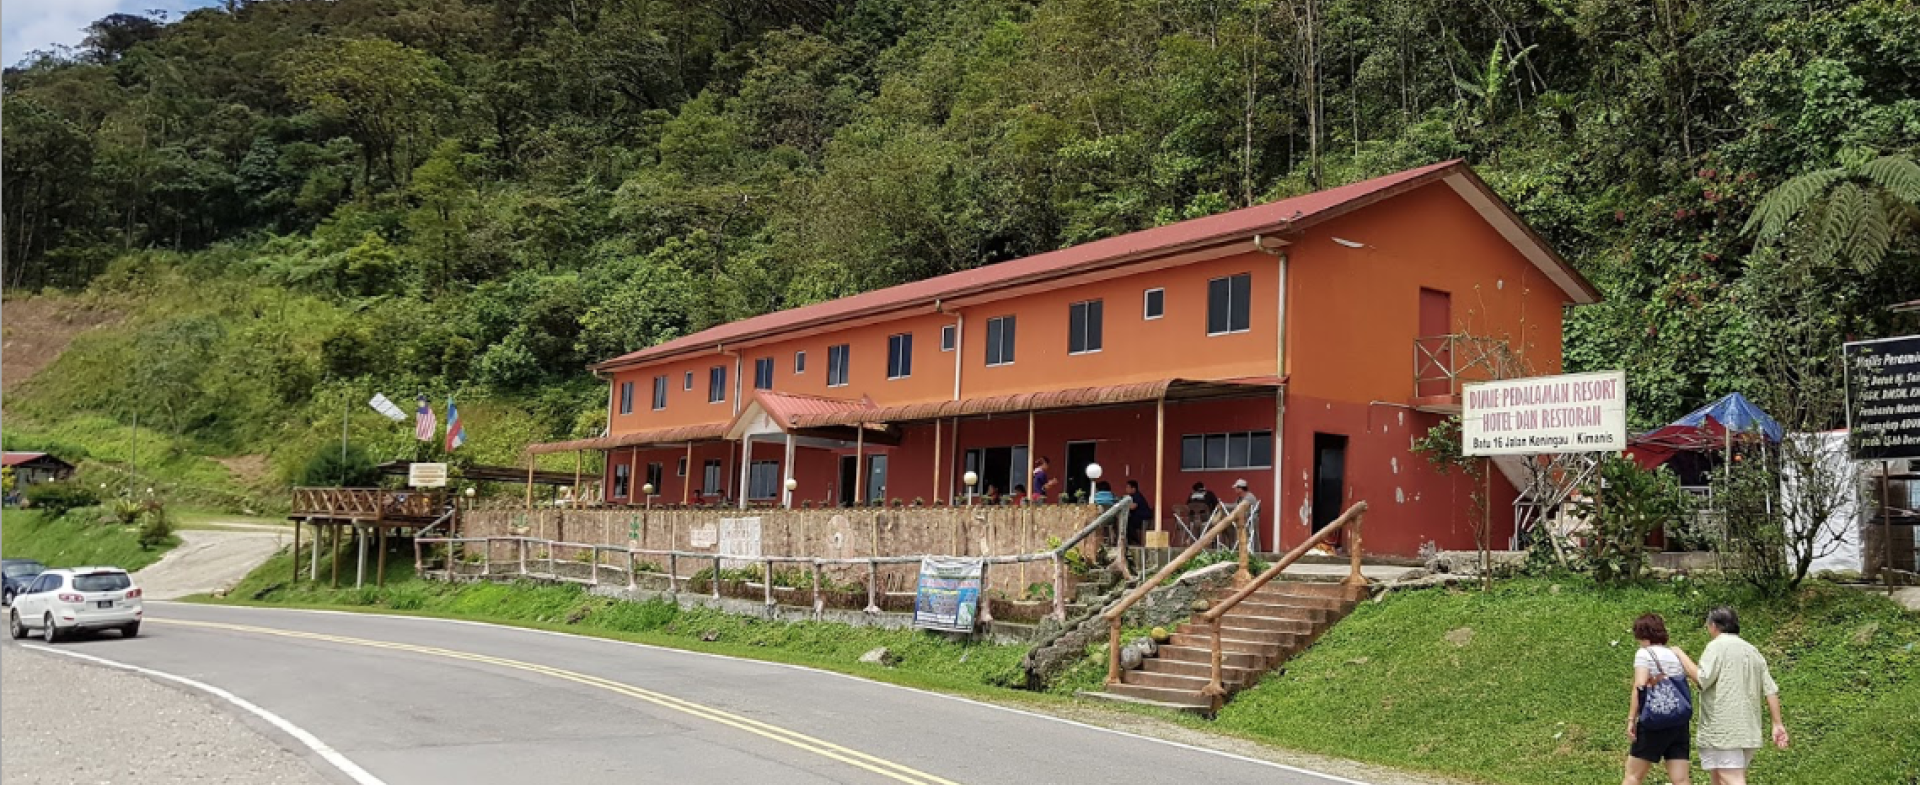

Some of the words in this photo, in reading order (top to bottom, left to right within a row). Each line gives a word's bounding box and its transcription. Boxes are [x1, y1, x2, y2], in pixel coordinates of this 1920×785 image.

[1503, 383, 1569, 407] PEDALAMAN
[1573, 379, 1617, 402] RESORT
[1483, 411, 1512, 432] HOTEL
[1516, 408, 1538, 430] DAN
[1542, 405, 1601, 428] RESTORAN
[1473, 437, 1491, 449] Batu
[1493, 436, 1502, 448] 16
[1505, 435, 1526, 447] Jalan
[1529, 434, 1568, 449] Keningau
[1577, 430, 1614, 443] Kimanis
